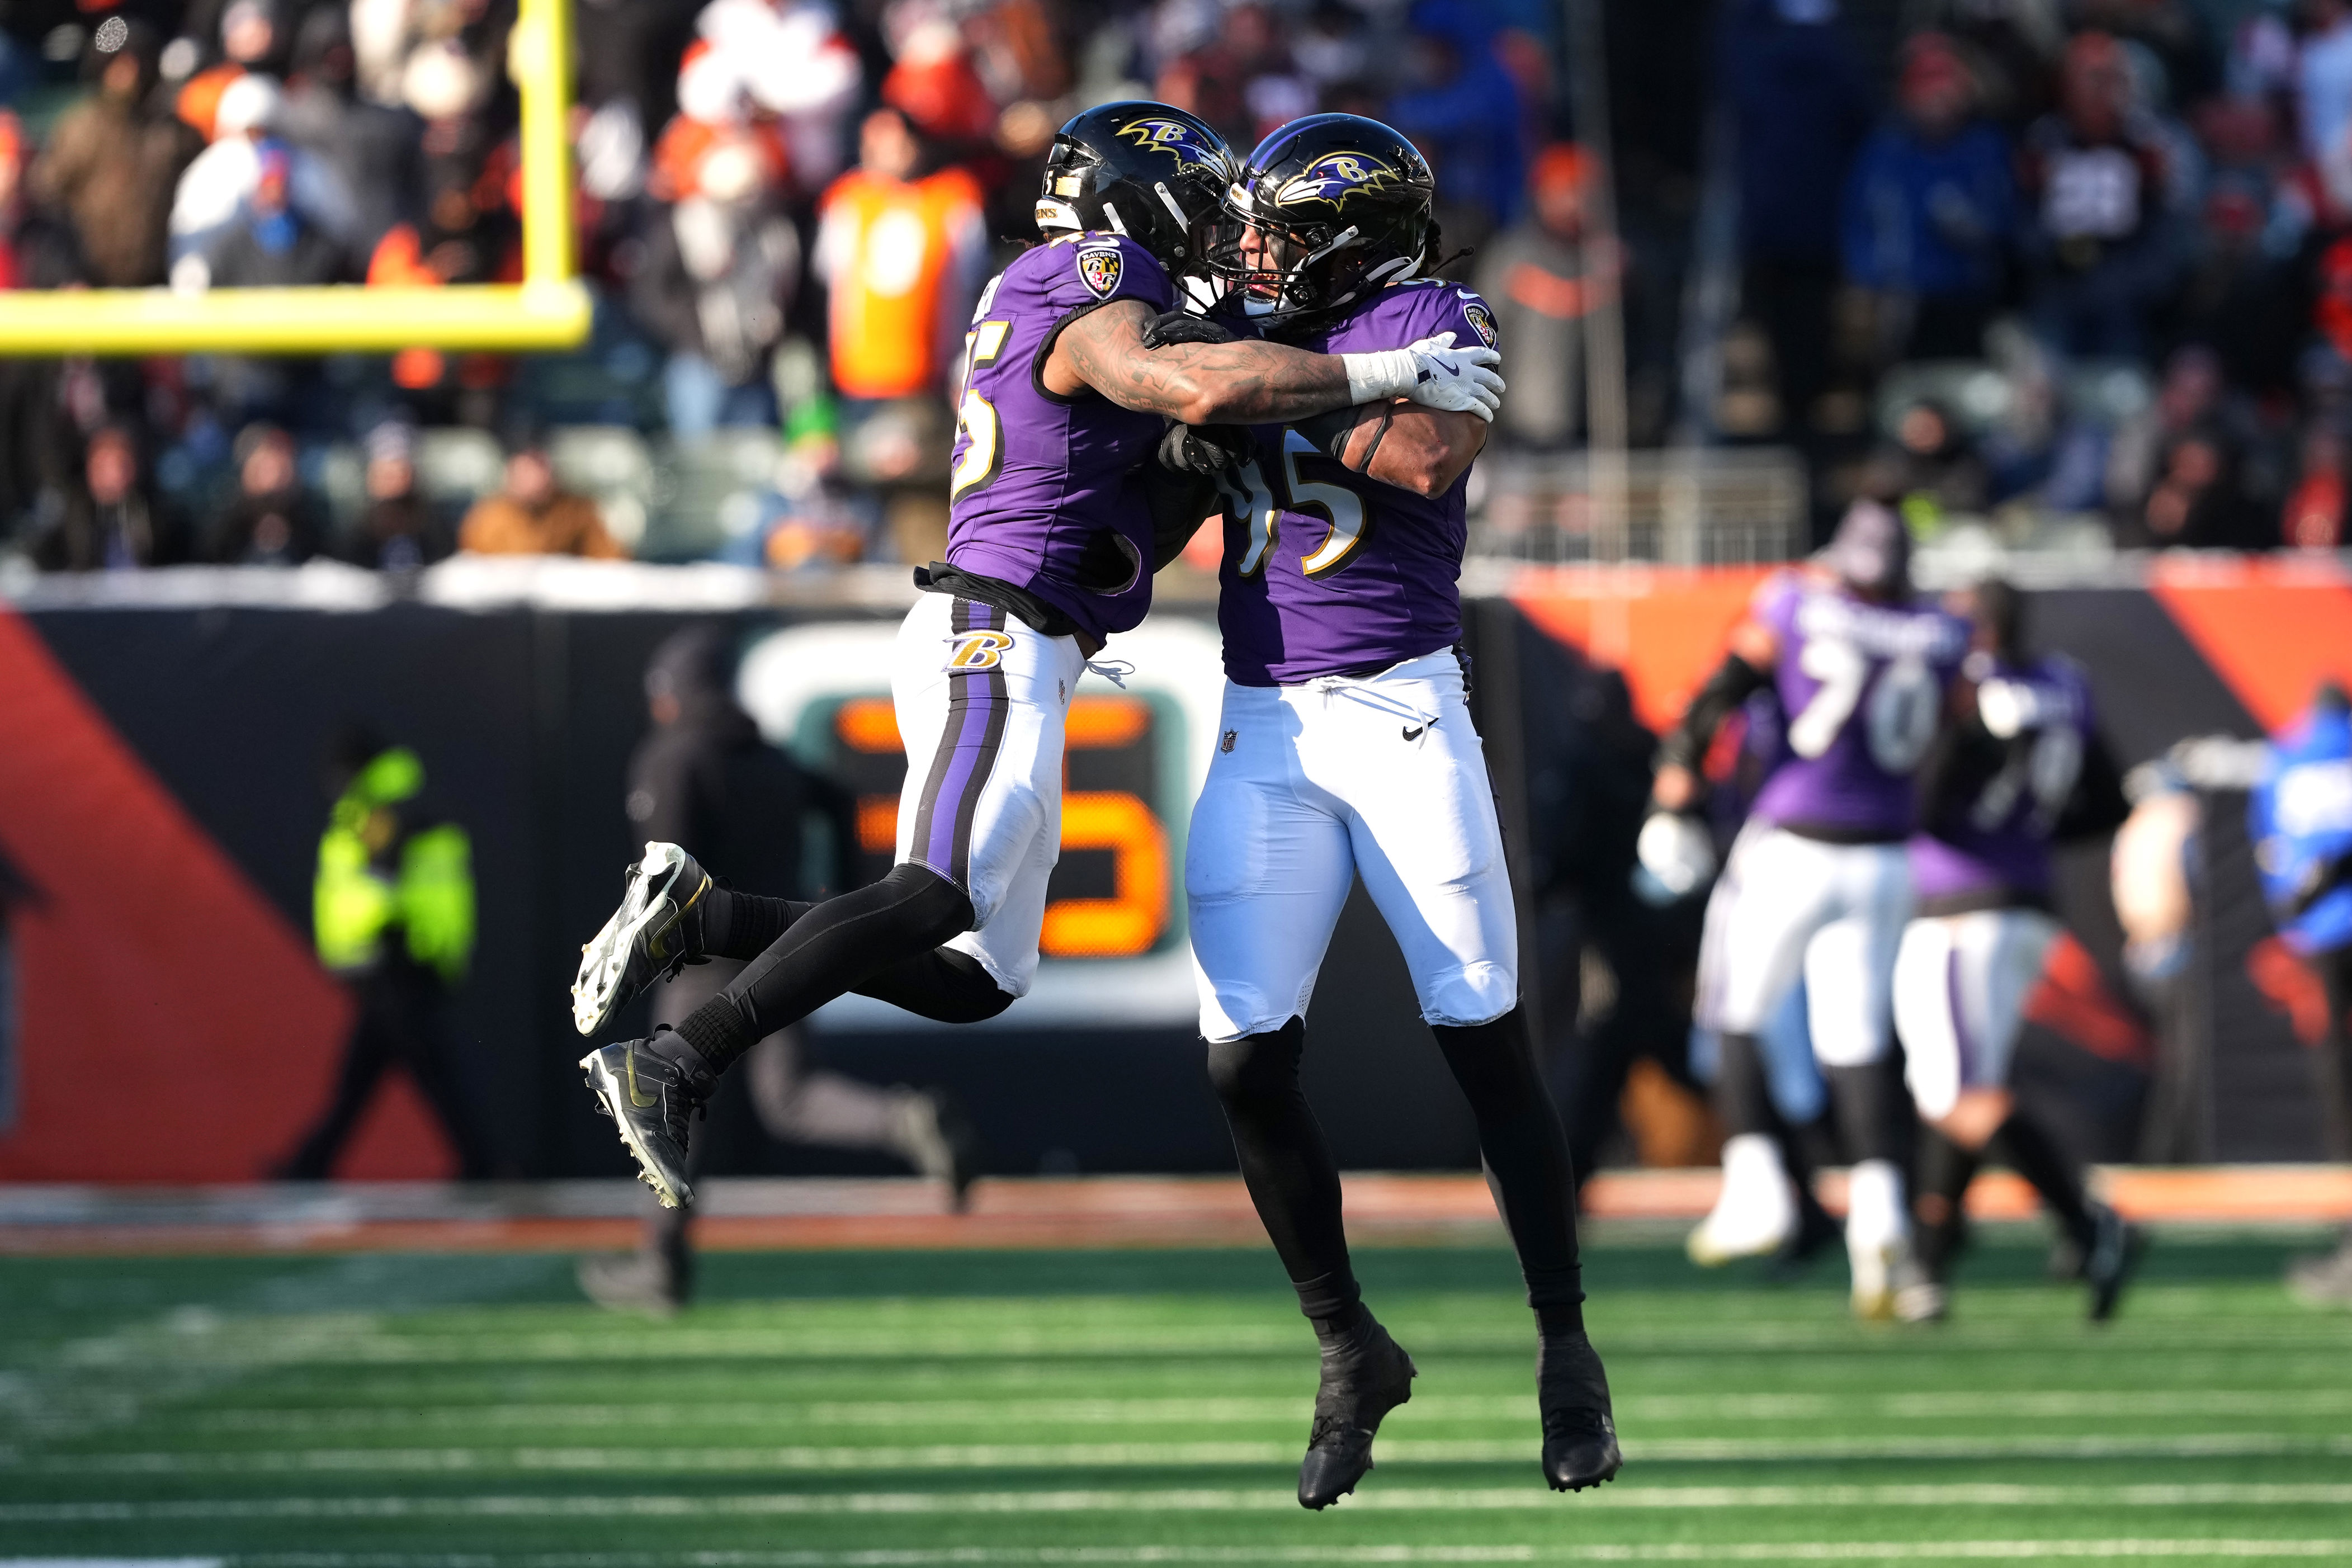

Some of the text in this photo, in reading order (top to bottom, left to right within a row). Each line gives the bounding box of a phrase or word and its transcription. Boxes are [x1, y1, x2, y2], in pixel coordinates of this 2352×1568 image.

[1145, 121, 1187, 141] B
[1319, 157, 1368, 182] B
[1081, 252, 1117, 261] RAVENS
[1085, 259, 1102, 273] B
[1467, 308, 1485, 318] RAVENS
[1212, 426, 1370, 579] 95
[941, 630, 1013, 672] B
[1222, 739, 1234, 749] NFL
